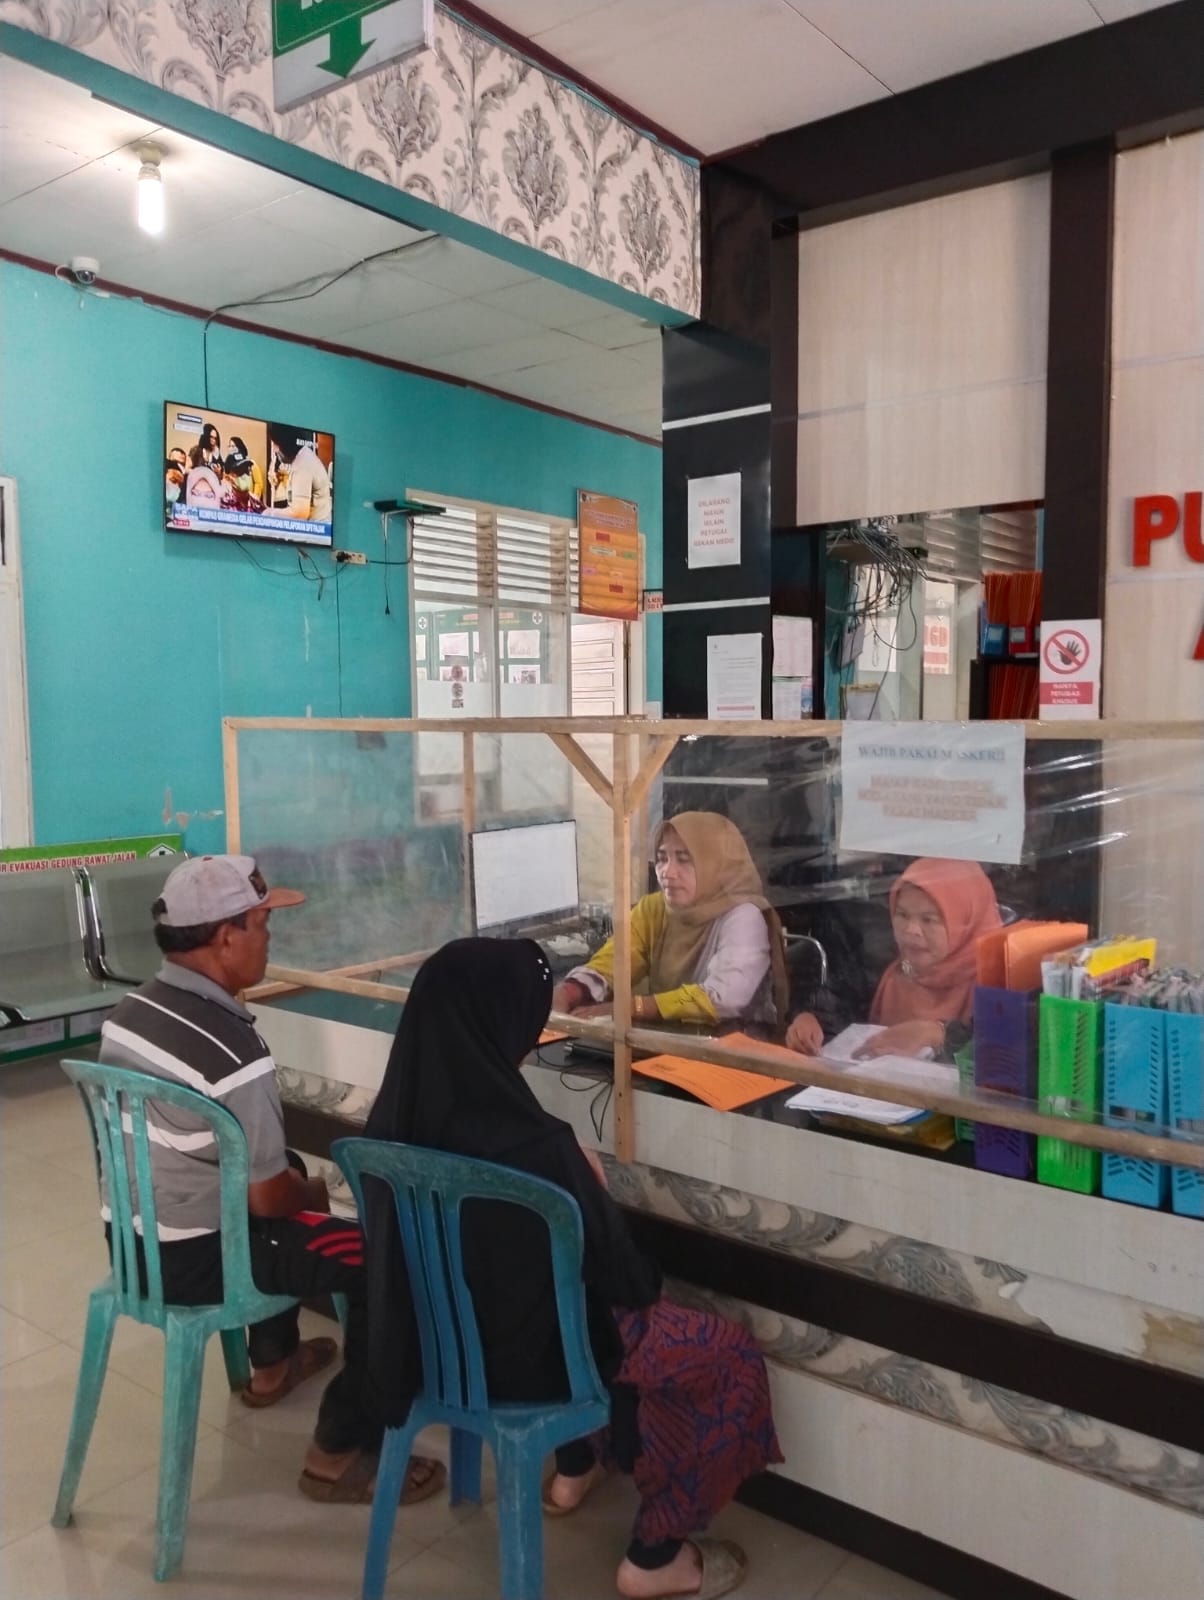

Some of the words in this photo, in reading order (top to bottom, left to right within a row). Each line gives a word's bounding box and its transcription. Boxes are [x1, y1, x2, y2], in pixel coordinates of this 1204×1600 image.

[857, 745, 895, 758] WAJIB
[9, 860, 48, 872] EVAKUASI
[50, 857, 82, 869] GEDUNG
[84, 854, 111, 866] RAWAT
[112, 851, 136, 862] JALAN
